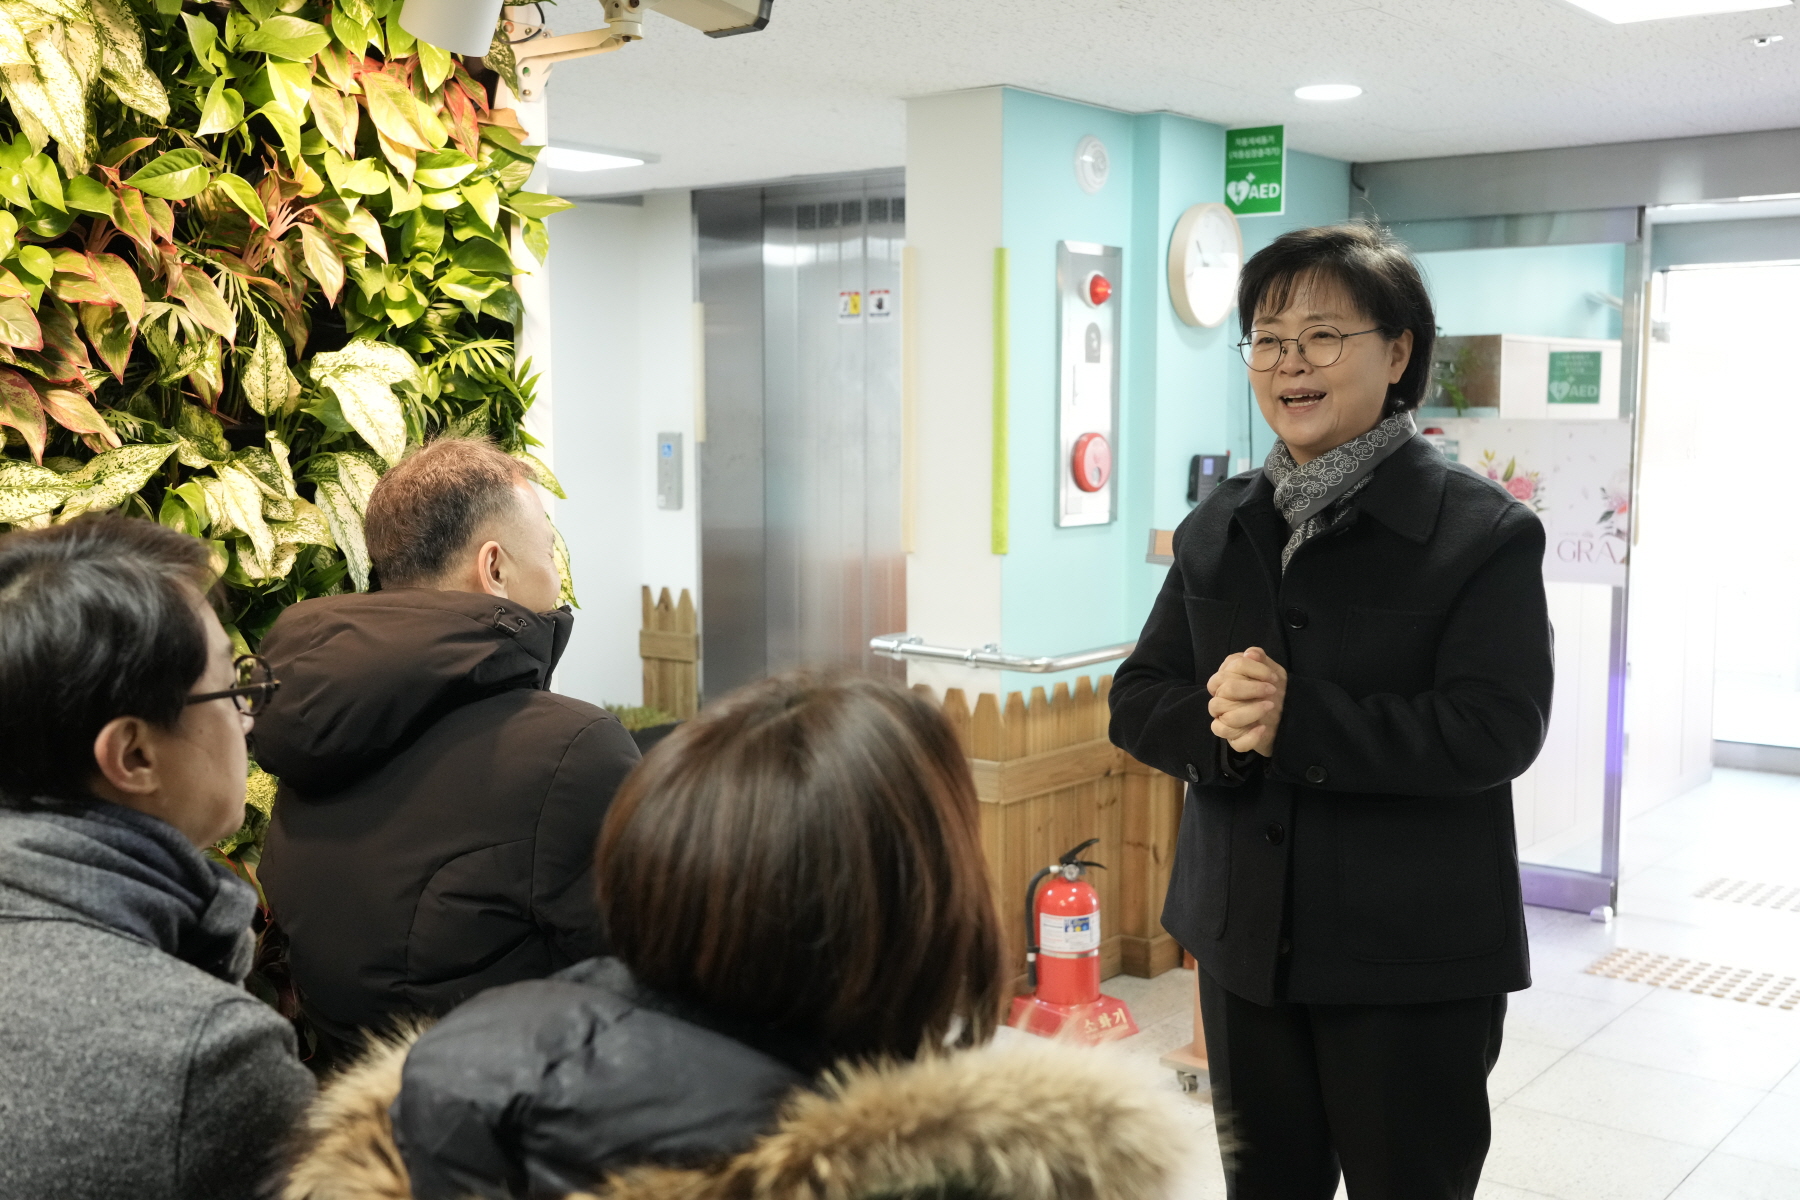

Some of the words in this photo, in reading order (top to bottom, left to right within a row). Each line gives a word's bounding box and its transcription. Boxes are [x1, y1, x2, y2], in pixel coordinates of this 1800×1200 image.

[1248, 183, 1280, 199] AED
[1568, 385, 1598, 397] AED
[1085, 1007, 1128, 1033] 소화기
